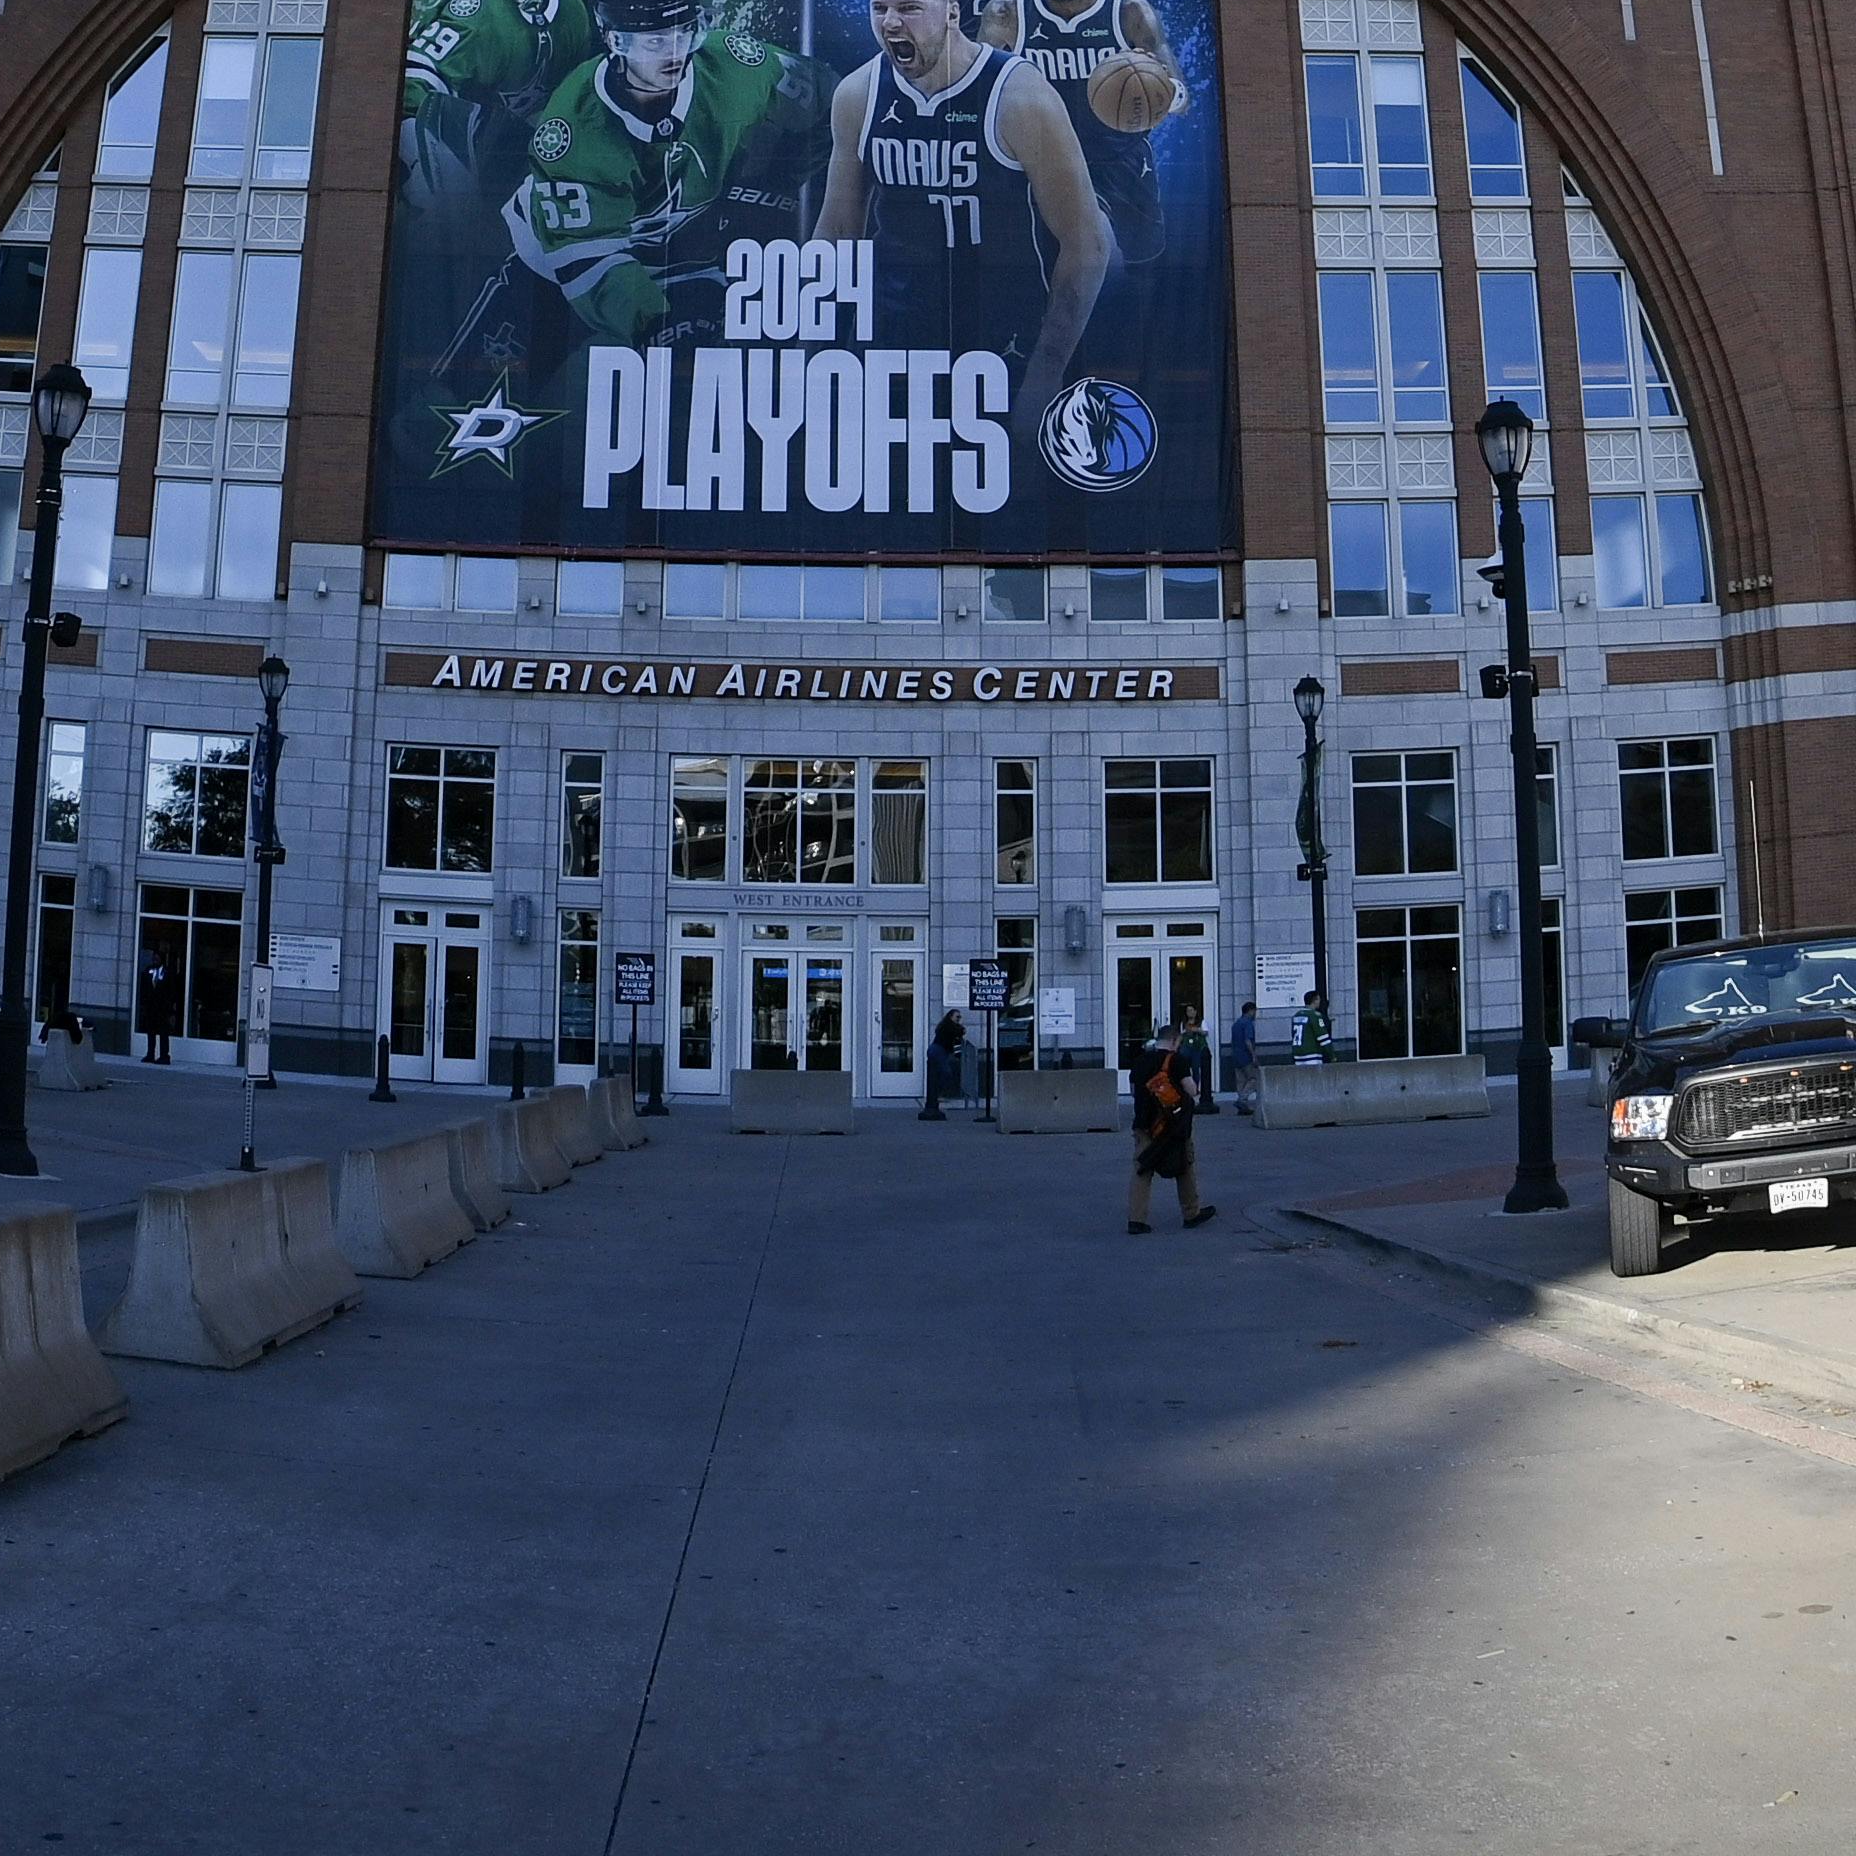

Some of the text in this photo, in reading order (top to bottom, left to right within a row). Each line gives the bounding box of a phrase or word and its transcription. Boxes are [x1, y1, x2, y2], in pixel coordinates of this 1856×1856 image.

[945, 111, 978, 124] chime
[871, 136, 978, 188] MAVS
[927, 194, 982, 249] 77
[724, 238, 874, 342] 2024
[582, 346, 1010, 514] PLAYOFFS
[432, 655, 1174, 700] AMERICAN AIRLINES CENTER
[734, 894, 865, 908] WEST ENTRANCE
[971, 970, 982, 978] NO
[982, 970, 999, 978] BAGS
[974, 978, 988, 986] THIS
[1728, 1005, 1768, 1015] K9
[1293, 1024, 1303, 1046] 21
